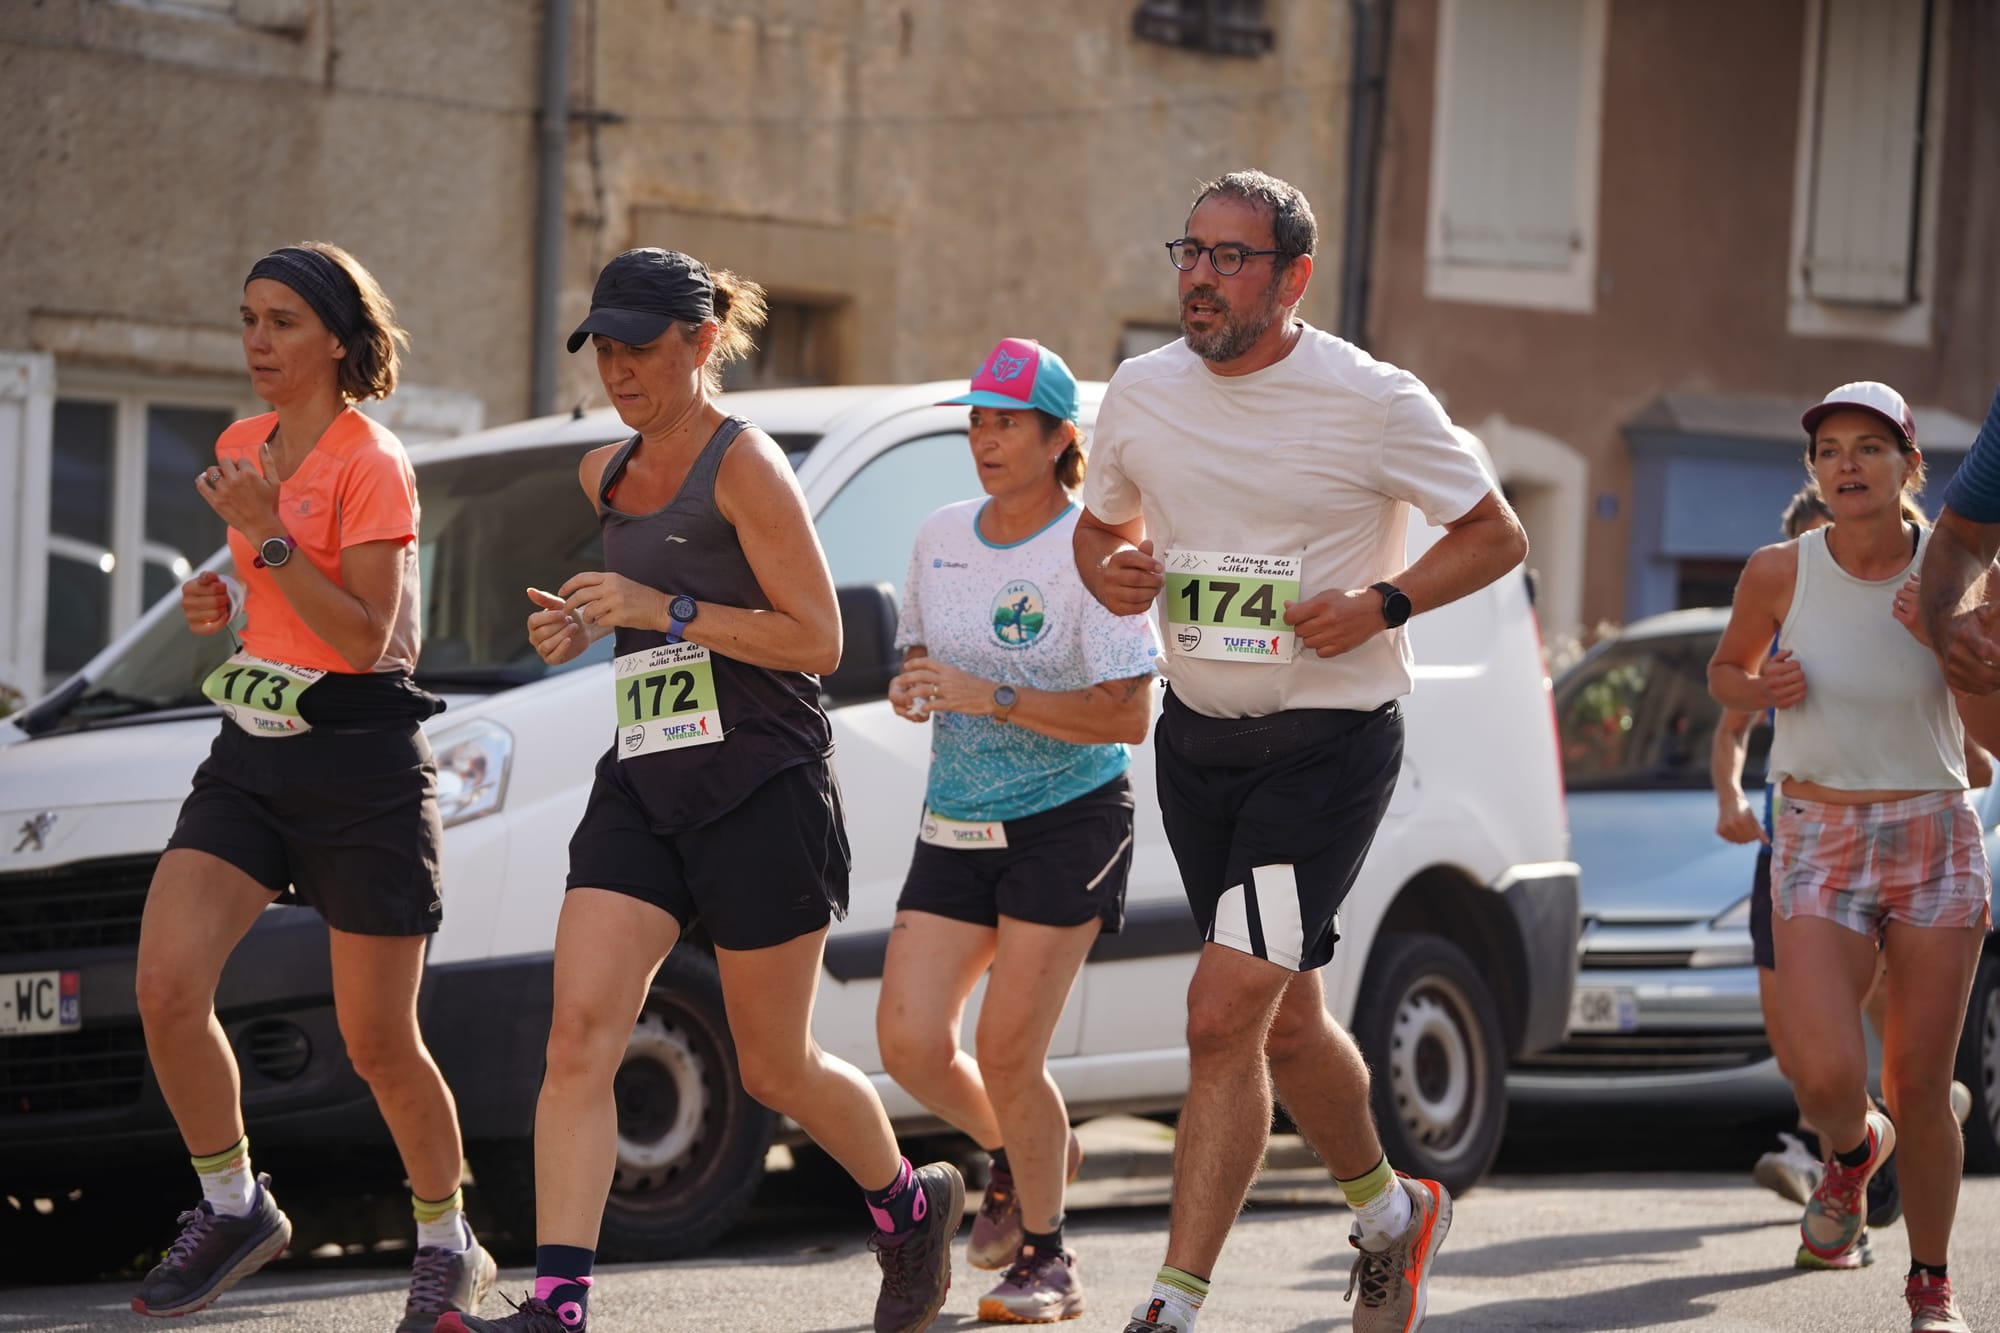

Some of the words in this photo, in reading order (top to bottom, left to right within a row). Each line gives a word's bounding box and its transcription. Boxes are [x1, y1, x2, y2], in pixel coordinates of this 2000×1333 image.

[1223, 555, 1269, 567] Challenge
[1274, 559, 1290, 567] des
[1217, 564, 1249, 573] vallées
[1254, 566, 1295, 576] cévenoles
[1181, 579, 1277, 626] 174
[1178, 633, 1197, 643] BFP
[1223, 637, 1266, 648] TUFF'S
[651, 647, 682, 658] Challenge
[686, 643, 699, 651] des
[1226, 644, 1270, 654] Aventure
[222, 667, 290, 711] 173
[627, 670, 699, 720] 172
[662, 722, 697, 736] TUFF'S
[626, 733, 642, 745] BFP
[666, 730, 700, 741] Aventure
